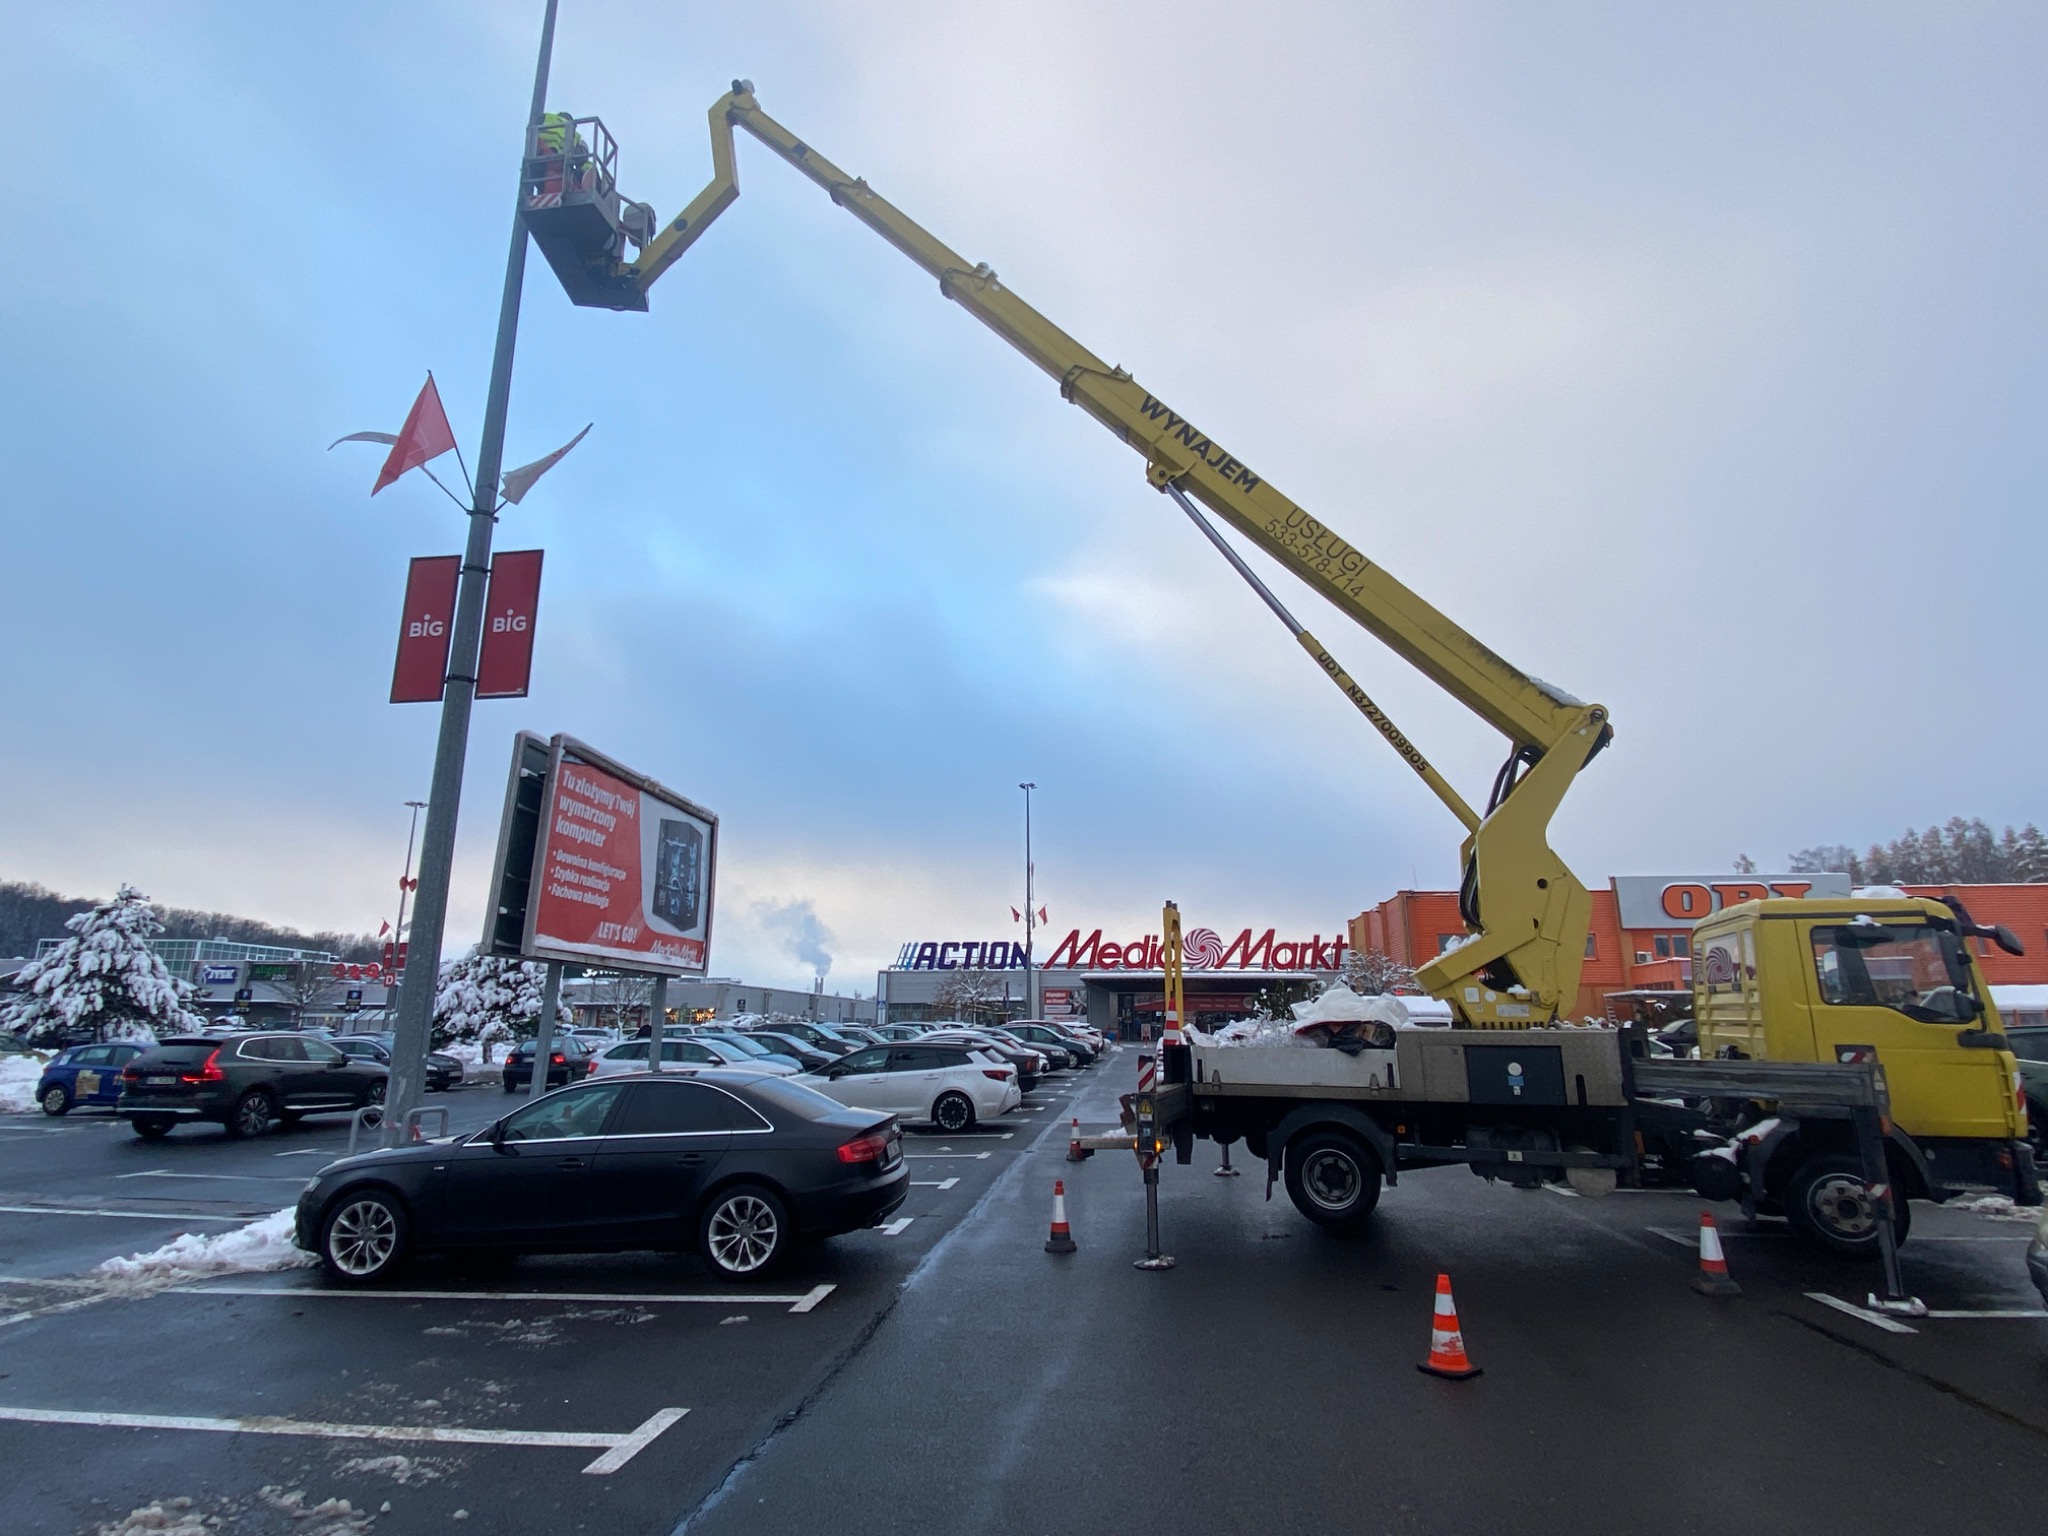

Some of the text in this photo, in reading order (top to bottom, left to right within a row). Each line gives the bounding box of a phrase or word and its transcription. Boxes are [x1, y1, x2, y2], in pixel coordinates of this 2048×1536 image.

[1139, 395, 1260, 494] WYNAJEM
[1265, 519, 1366, 598] 533-578-714
[1285, 508, 1371, 577] USŁUGI
[1318, 652, 1345, 678] UDT
[562, 770, 636, 819] Tu złożymy Twój
[559, 795, 616, 832] wymarzony
[555, 815, 607, 847] komputer
[556, 848, 588, 869] Dowolna
[551, 883, 583, 902] Fachowa
[597, 921, 638, 944] LET'S GO!
[913, 941, 1030, 970] ACTION
[1214, 929, 1348, 970] Markt
[385, 975, 393, 985] D
